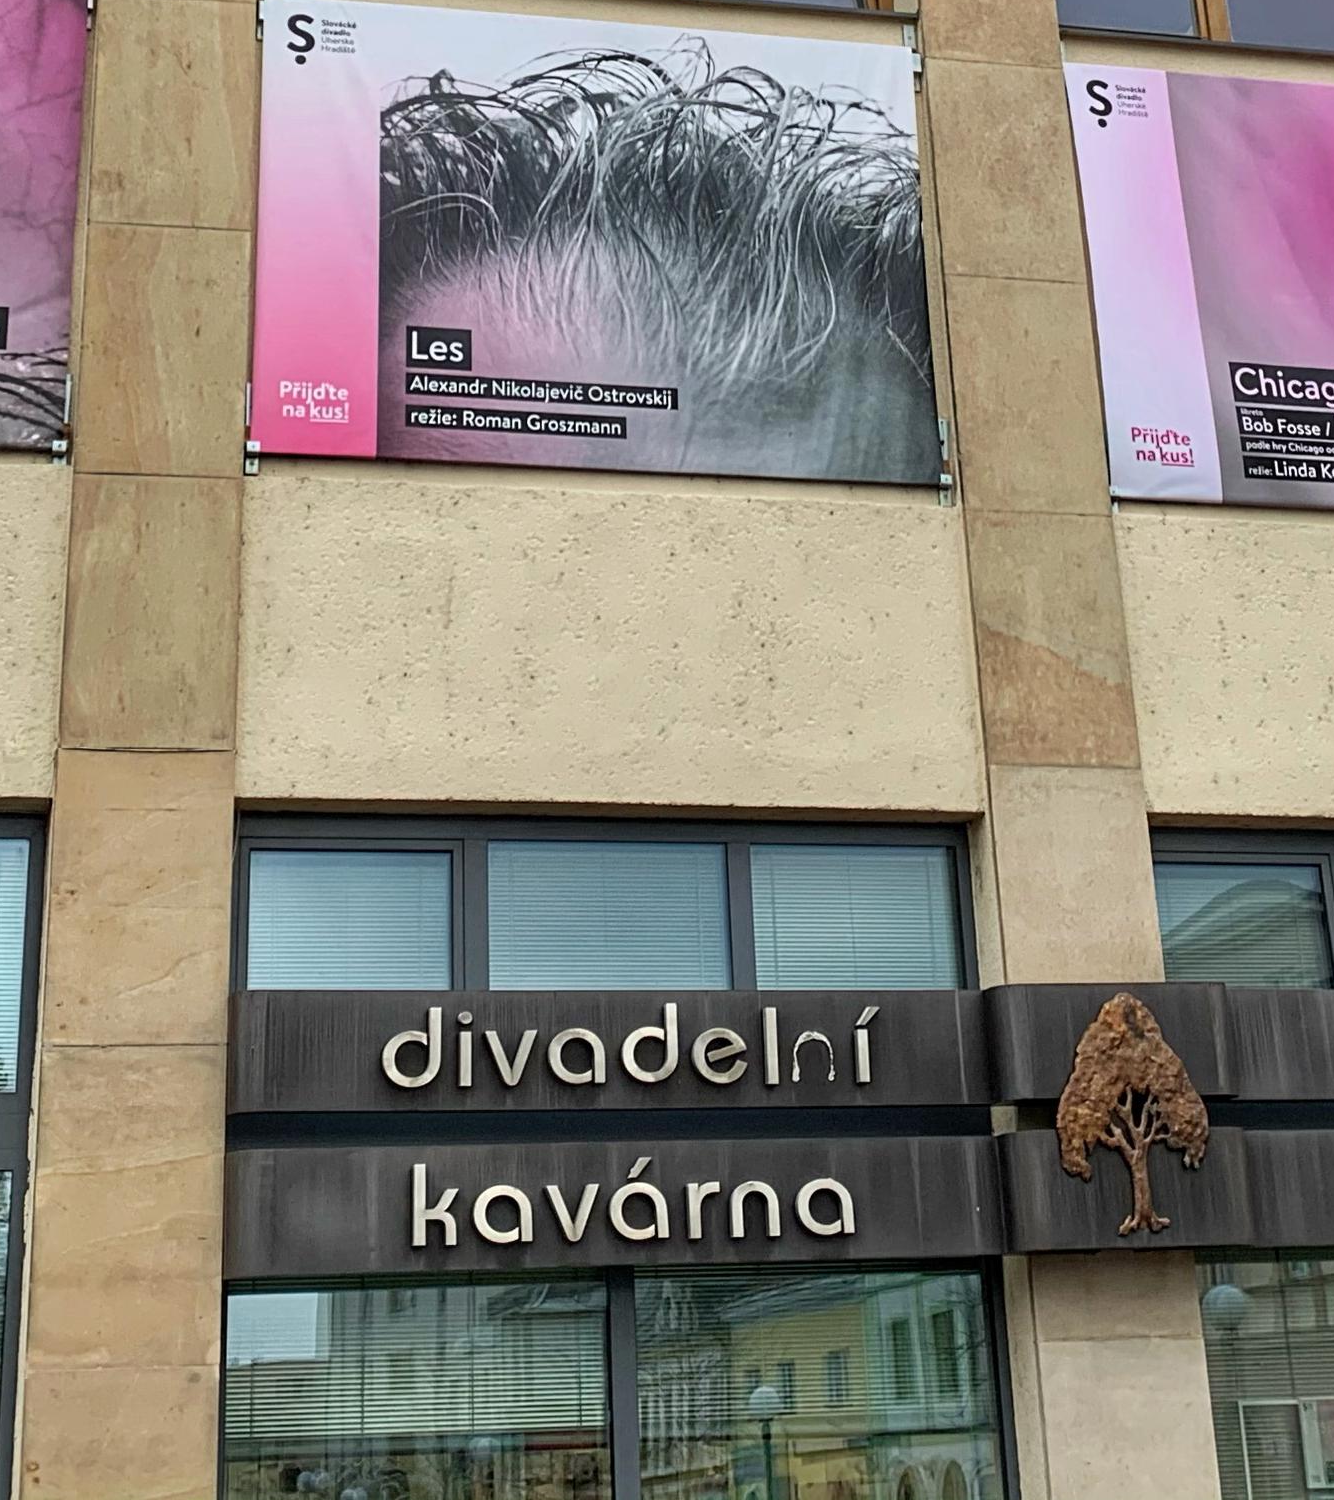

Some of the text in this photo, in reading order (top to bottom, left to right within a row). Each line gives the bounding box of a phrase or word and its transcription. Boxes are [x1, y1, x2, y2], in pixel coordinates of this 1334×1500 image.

[410, 330, 465, 363] Les
[279, 381, 349, 404] Přijďte
[409, 376, 673, 410] Alexandr Nikolajevič Ostrovskij
[282, 401, 350, 420] na kus!
[410, 409, 622, 436] režie: Roman Groszmann
[1242, 416, 1274, 433] Bob
[1277, 419, 1321, 436] Fosse
[1325, 421, 1331, 437] /
[1136, 447, 1194, 465] na kus!
[1288, 442, 1325, 455] Chicago
[1274, 460, 1317, 479] Linda
[380, 1001, 881, 1089] divadelní
[409, 1155, 857, 1248] kavárna
